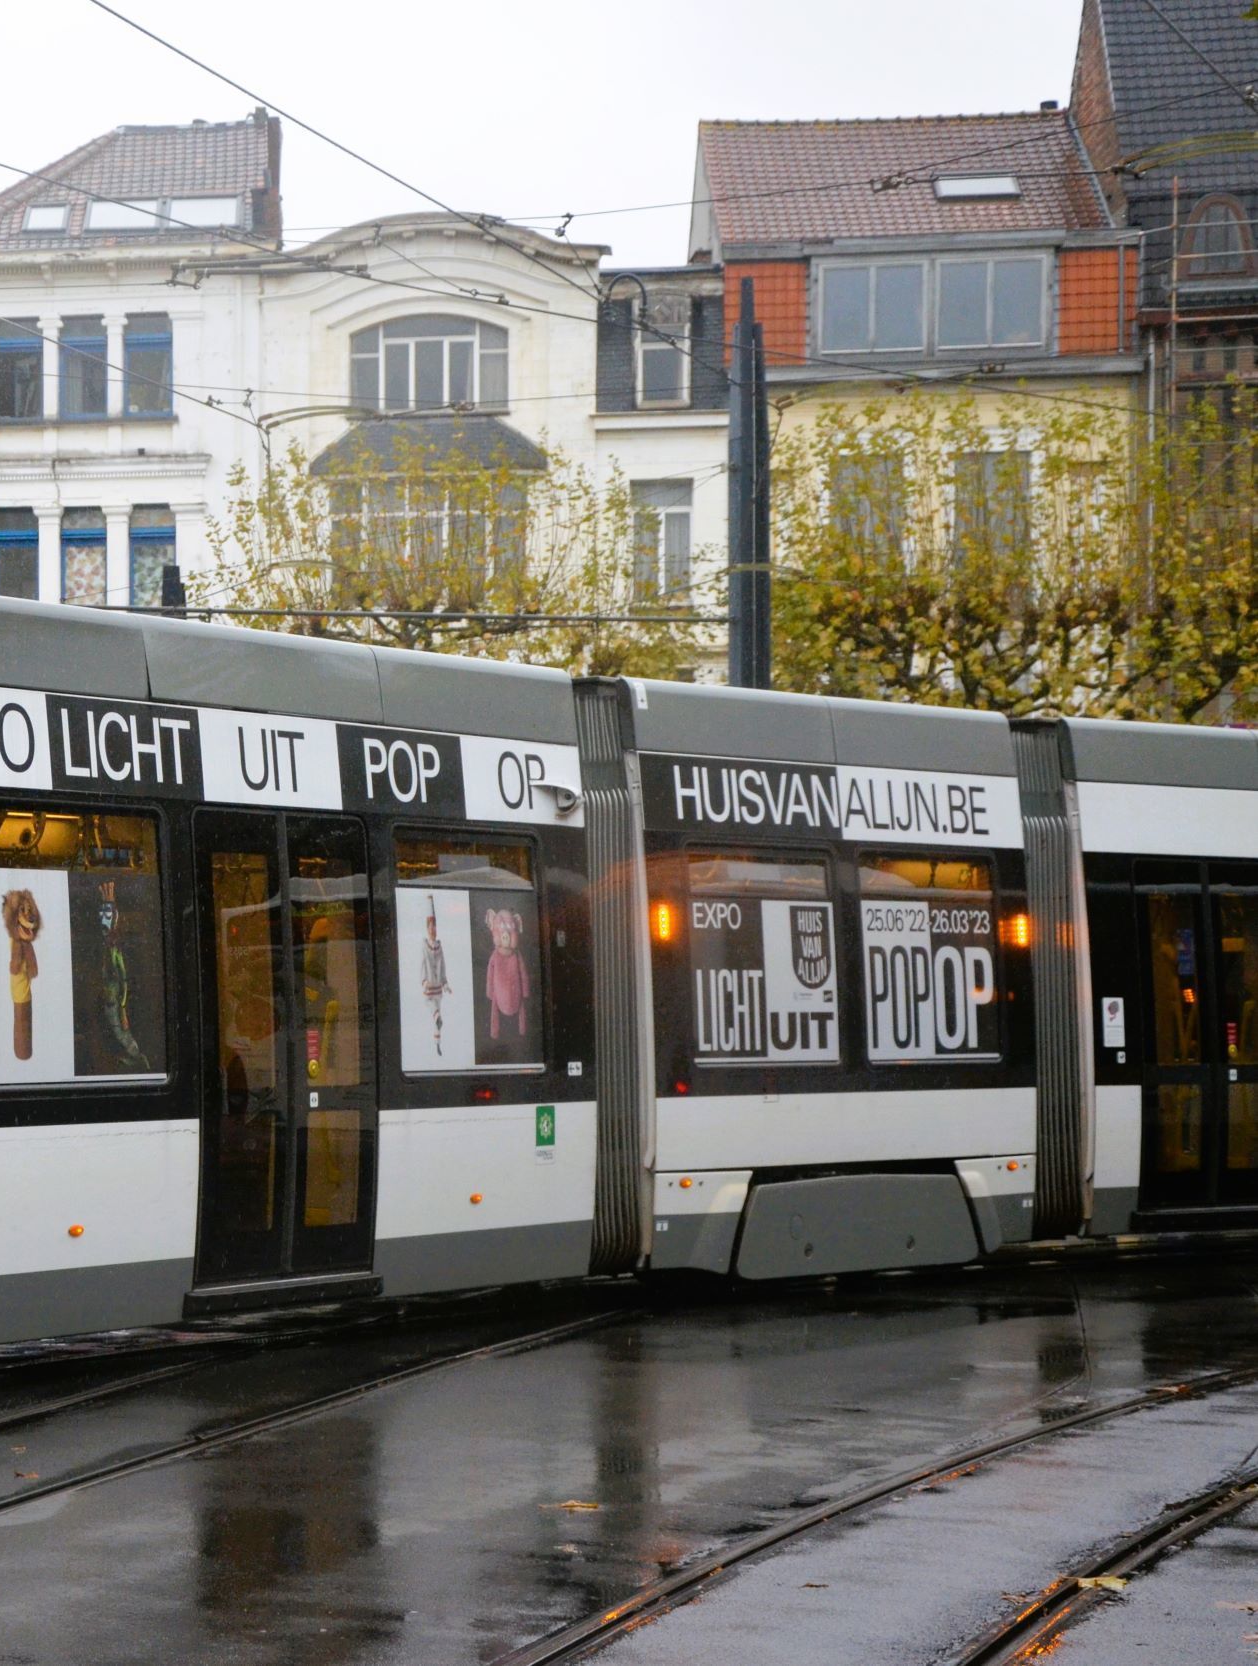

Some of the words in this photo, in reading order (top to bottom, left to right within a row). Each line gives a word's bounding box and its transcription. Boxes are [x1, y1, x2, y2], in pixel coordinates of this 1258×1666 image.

[60, 708, 191, 785] LICHT
[237, 727, 305, 793] UIT
[362, 738, 441, 803] POP
[498, 751, 545, 810] OP
[692, 902, 742, 930] EXPO
[797, 911, 823, 933] HUIS
[800, 935, 822, 959] VAN
[798, 956, 827, 984] ALIJN
[696, 968, 763, 1052] LICHT
[770, 1012, 834, 1050] UIT
